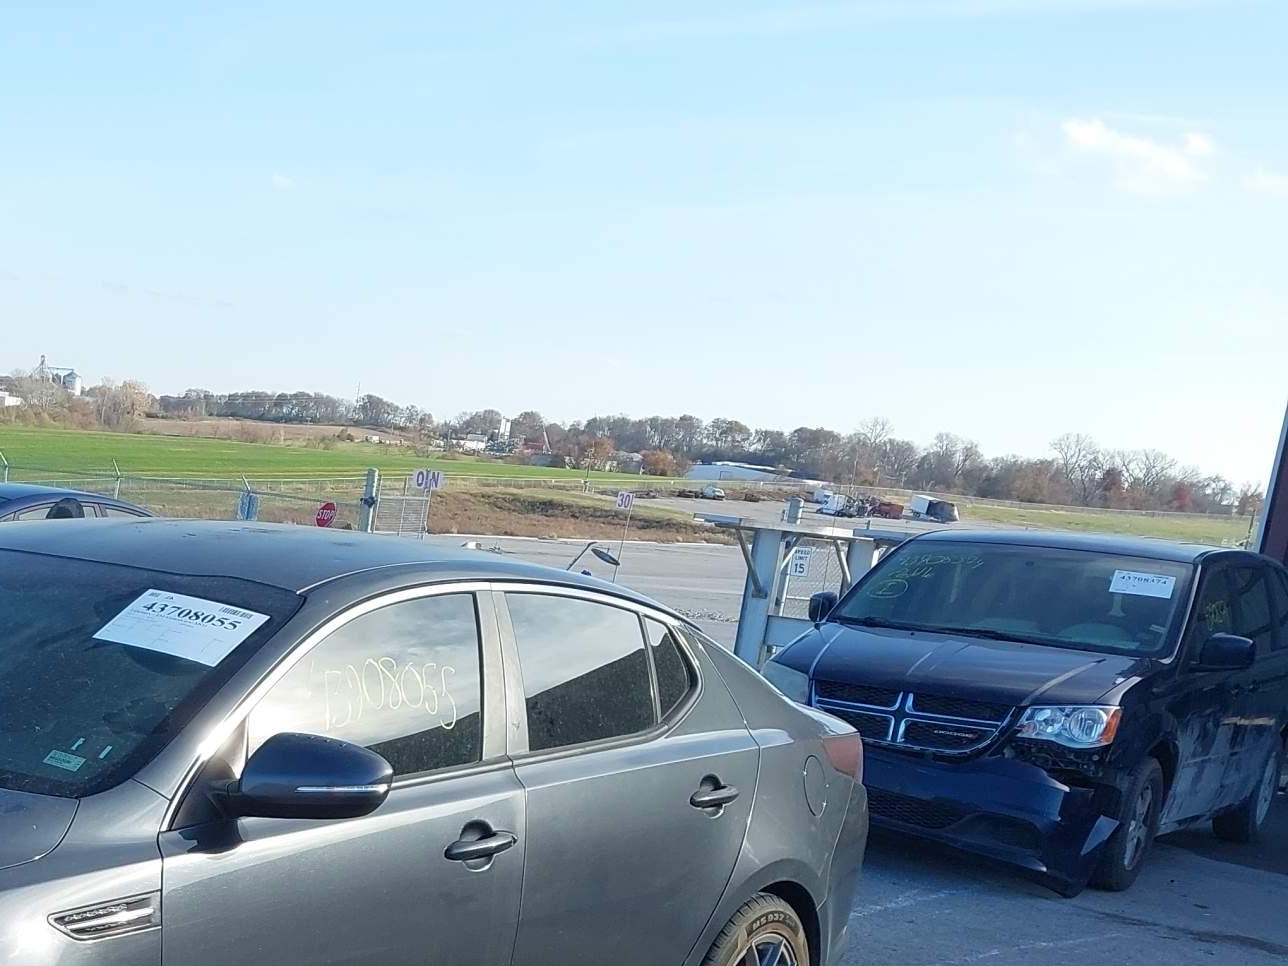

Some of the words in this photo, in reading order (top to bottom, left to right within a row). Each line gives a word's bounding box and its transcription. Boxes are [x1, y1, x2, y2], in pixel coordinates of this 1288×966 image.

[617, 493, 631, 508] 30
[317, 510, 334, 520] STOP
[794, 563, 805, 574] 15
[143, 601, 242, 631] 43708055
